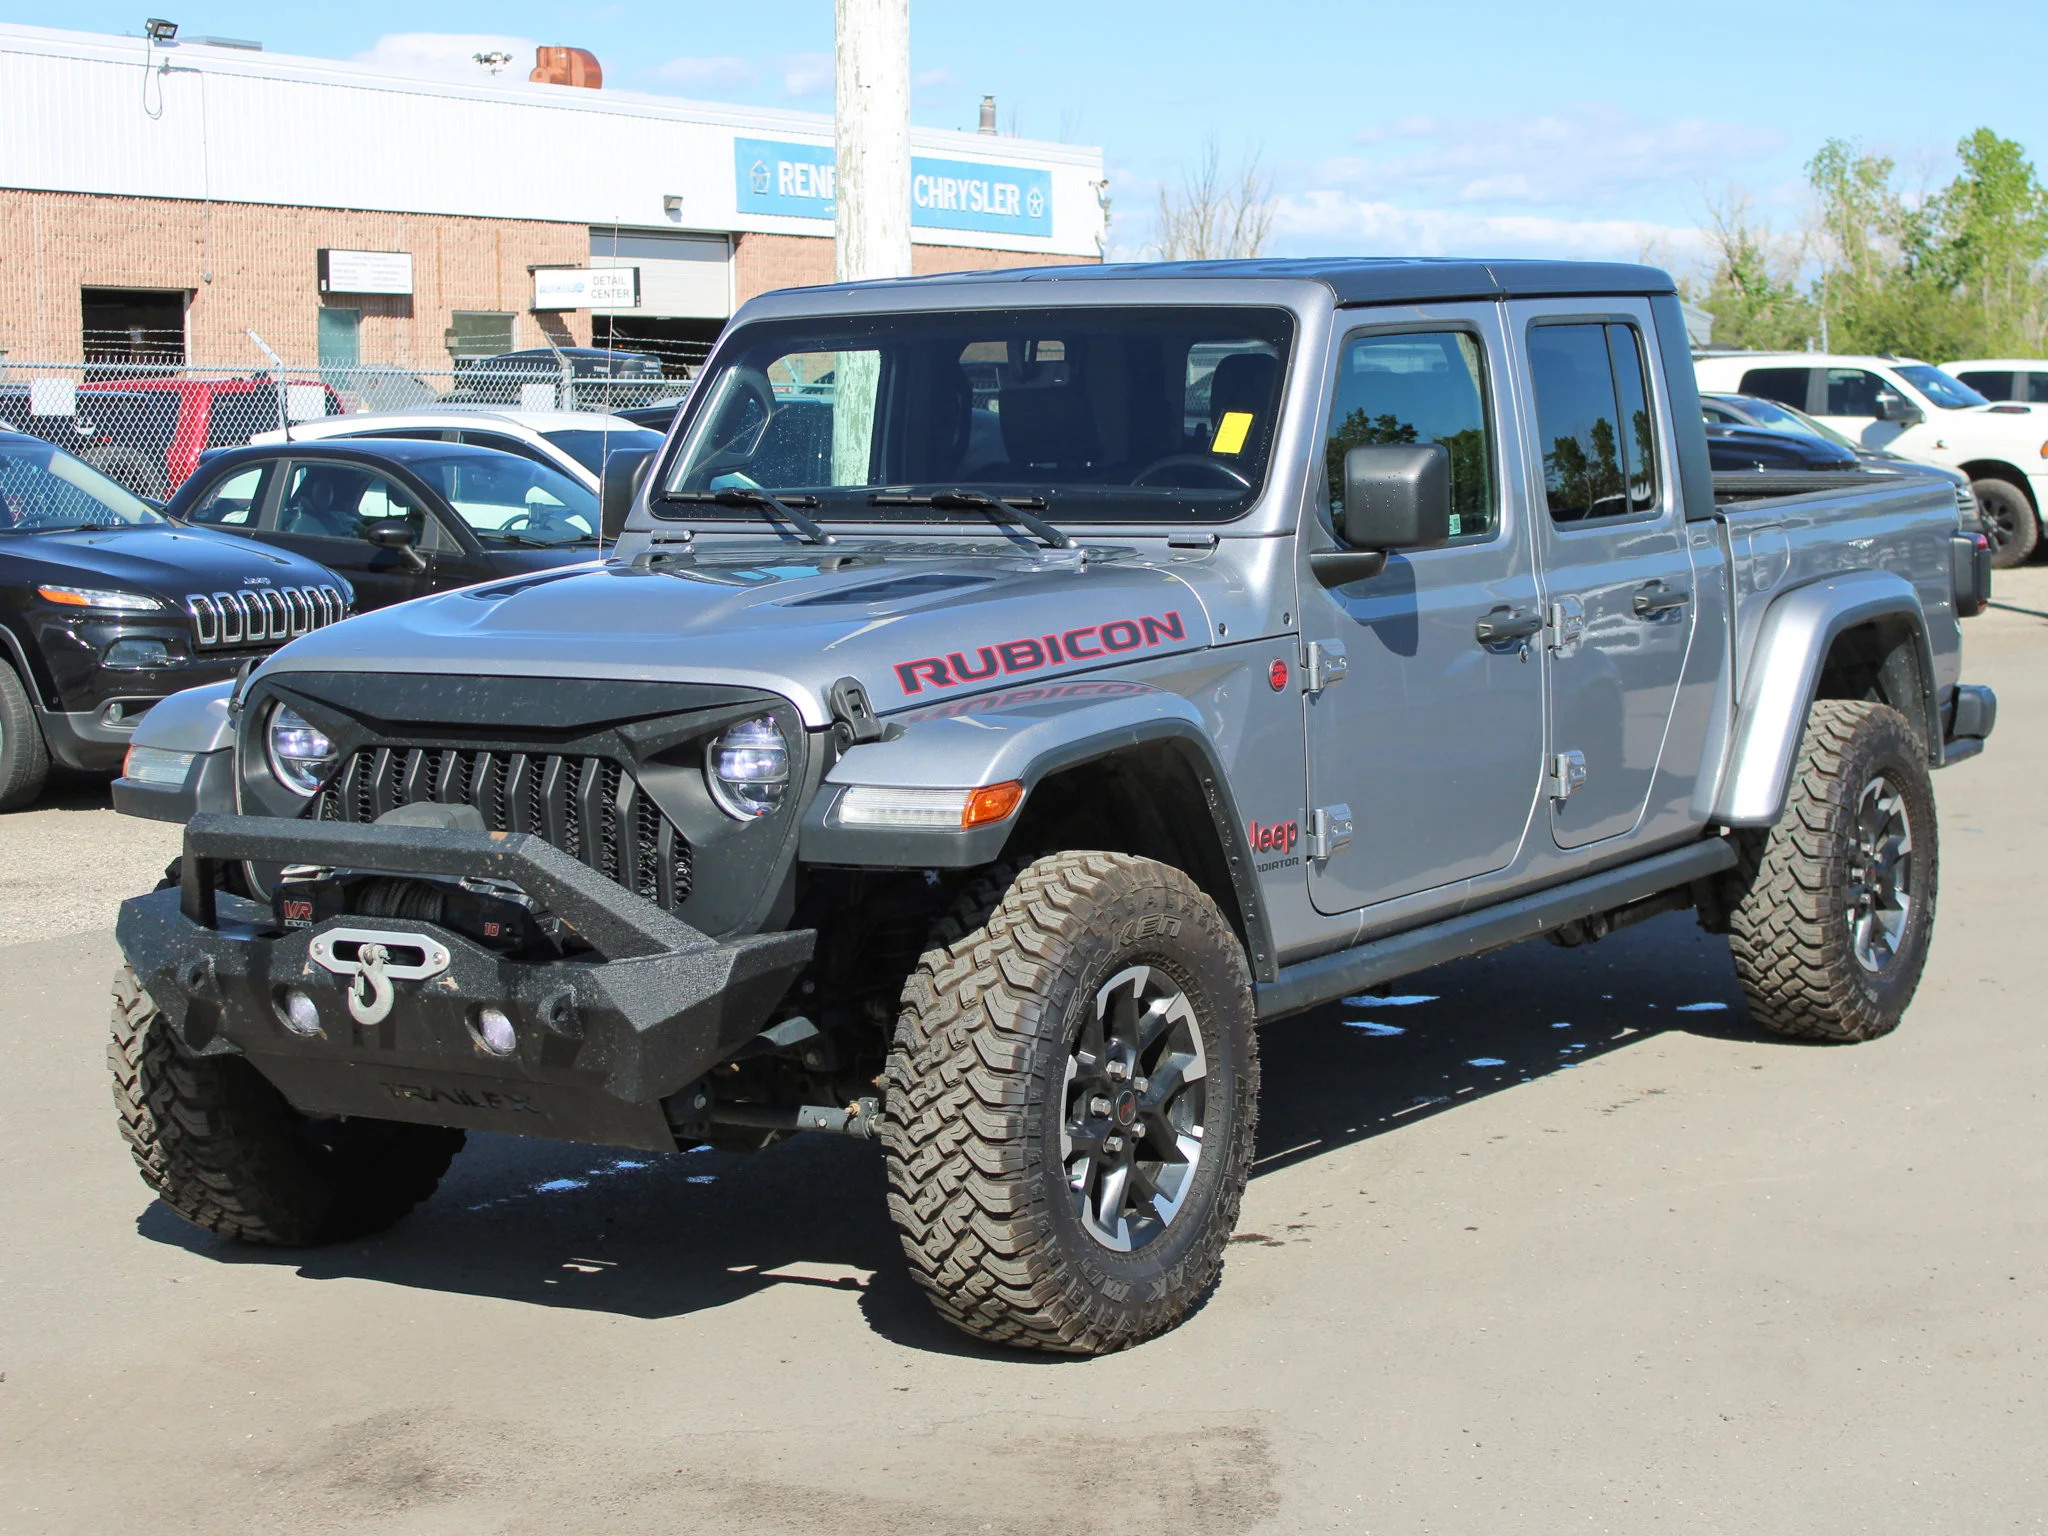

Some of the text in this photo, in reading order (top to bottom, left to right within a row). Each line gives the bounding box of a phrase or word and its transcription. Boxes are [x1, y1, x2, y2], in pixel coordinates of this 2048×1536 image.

[778, 161, 1020, 215] RENF CHRYSLER
[593, 276, 627, 286] DETAIL
[591, 289, 630, 299] CENTER
[893, 611, 1186, 695] RUBICON
[1250, 820, 1298, 854] Jeep
[1256, 857, 1298, 872] ADIATOR
[284, 900, 312, 920] VR
[484, 922, 499, 936] 10
